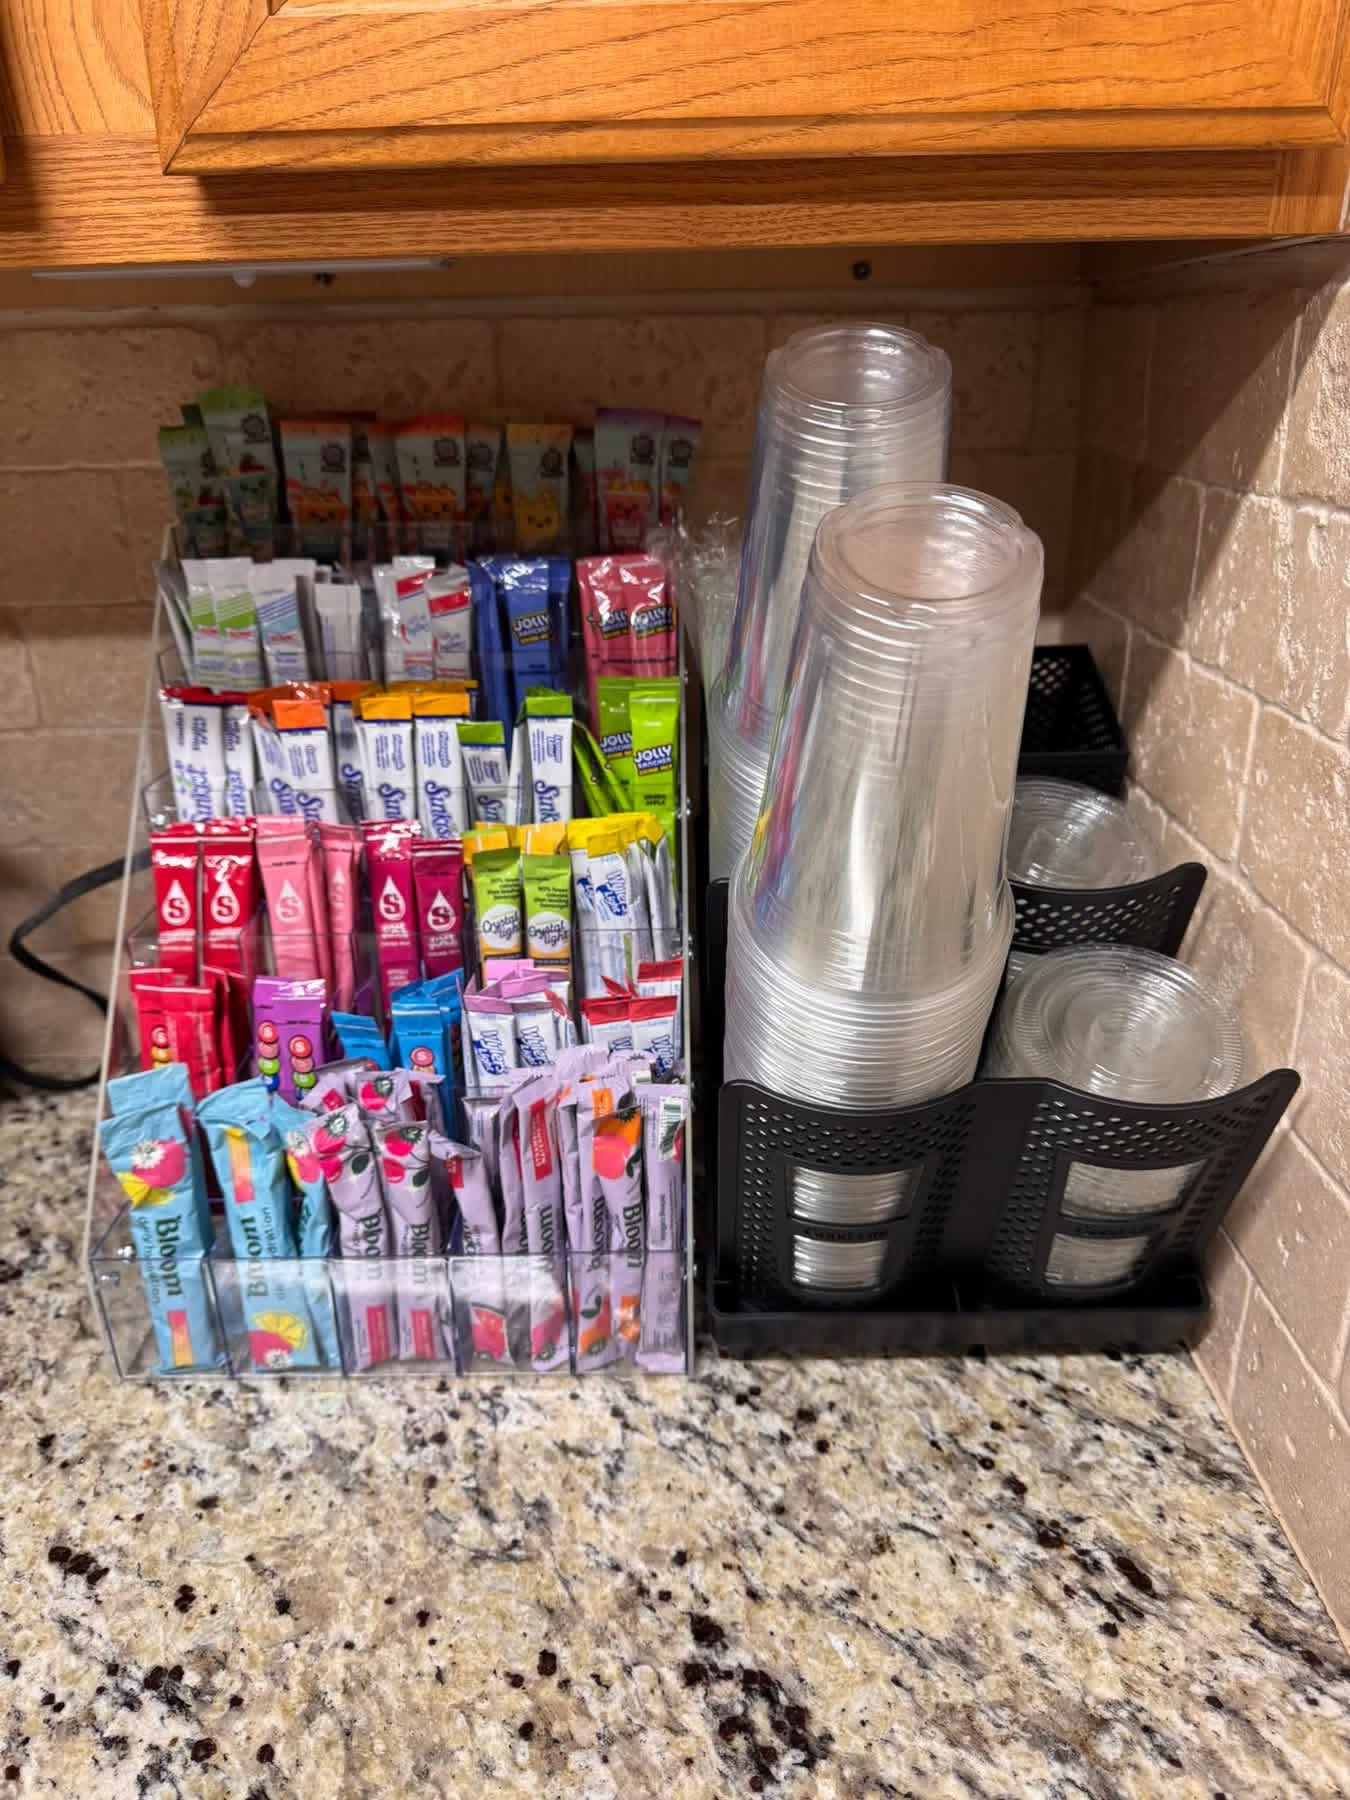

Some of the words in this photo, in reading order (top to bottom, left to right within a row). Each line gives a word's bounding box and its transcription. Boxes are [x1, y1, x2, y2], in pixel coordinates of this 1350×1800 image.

[514, 615, 549, 631] JOLLY
[634, 744, 672, 763] JOLLY
[534, 780, 561, 824] Sunk
[167, 898, 185, 919] S
[215, 896, 235, 918] S
[281, 899, 299, 919] S
[383, 894, 400, 914] S
[431, 907, 451, 926] S
[527, 919, 564, 939] Crystal
[480, 1029, 509, 1074] Wyler's
[359, 1210, 384, 1280] Bloom
[623, 1202, 643, 1269] Bloom
[155, 1215, 183, 1297] Bloom
[241, 1215, 270, 1298] Bloom
[410, 1220, 431, 1285] Bloom
